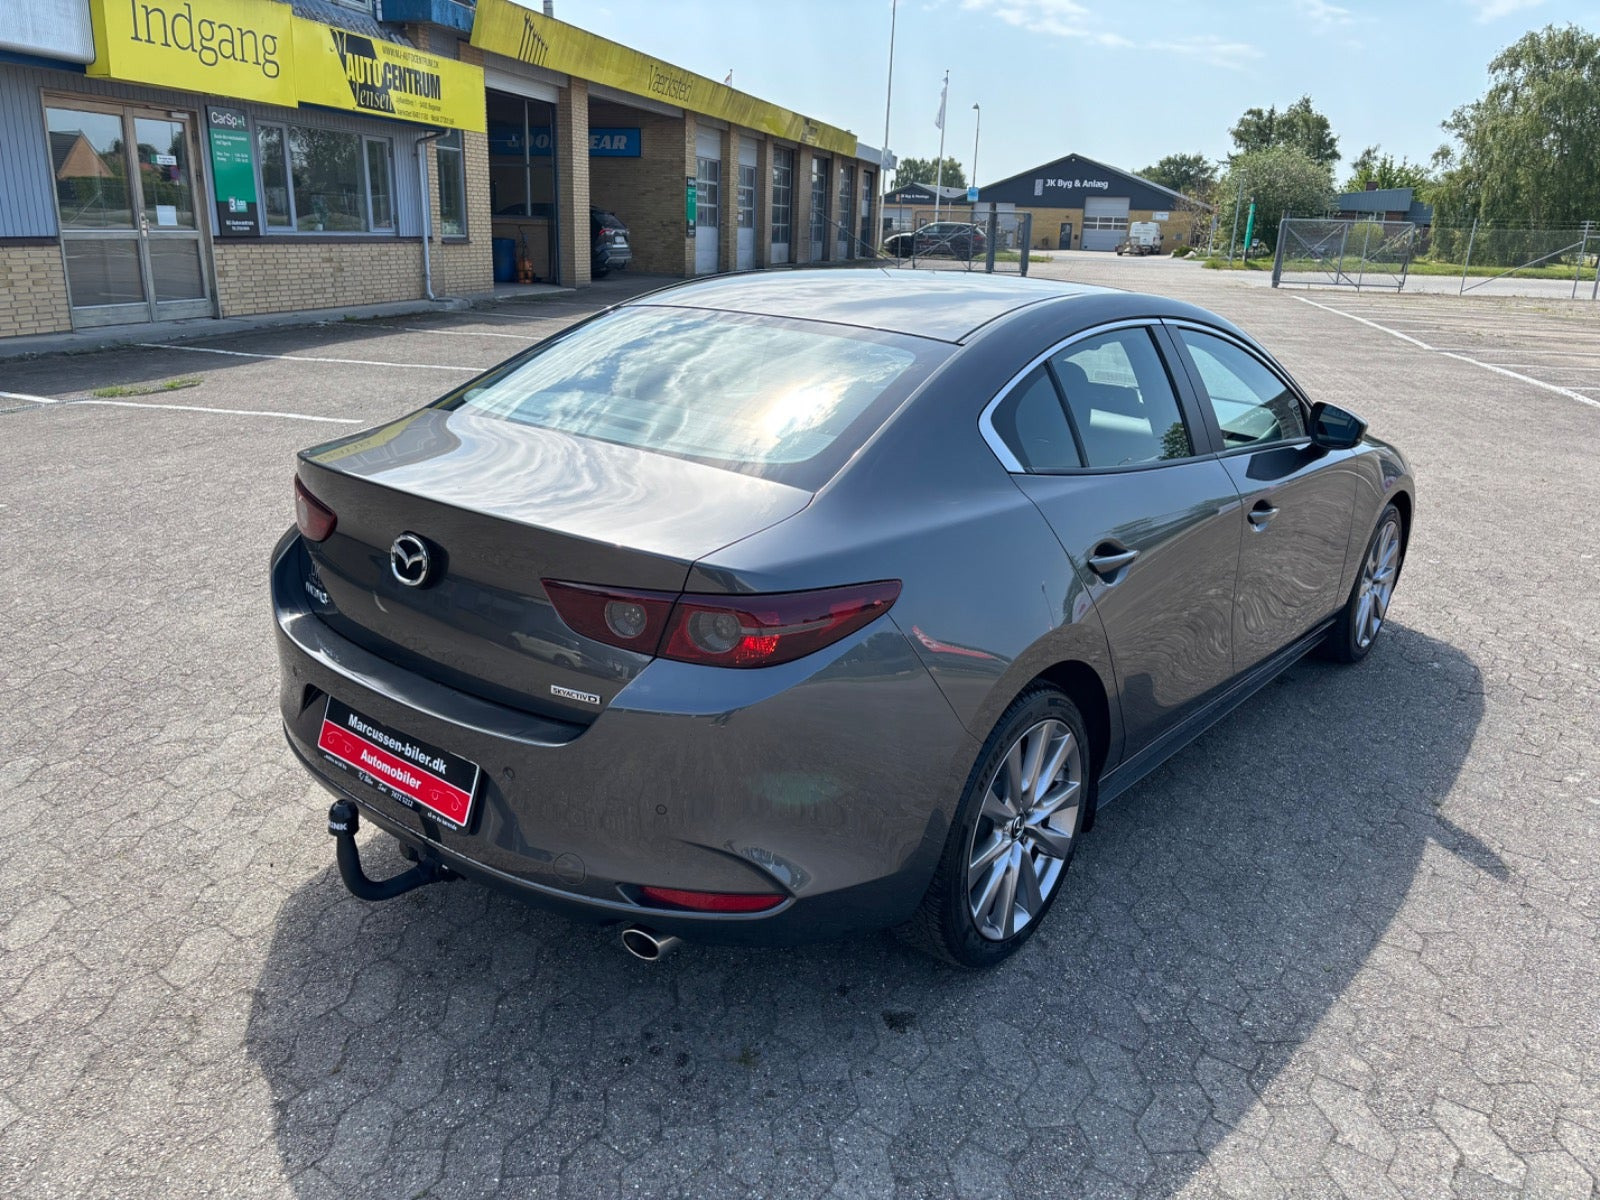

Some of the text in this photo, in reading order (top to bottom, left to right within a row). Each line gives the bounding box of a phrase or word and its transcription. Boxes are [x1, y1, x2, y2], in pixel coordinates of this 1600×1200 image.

[131, 0, 280, 79] Indgang
[648, 64, 694, 104] Værksted
[211, 111, 246, 128] CarSpt
[506, 134, 628, 150] GOOEAR
[1045, 179, 1056, 187] JK
[1057, 179, 1073, 189] Byg
[348, 713, 447, 775] Marcussen-biler.dk
[360, 748, 421, 790] Automobiler
